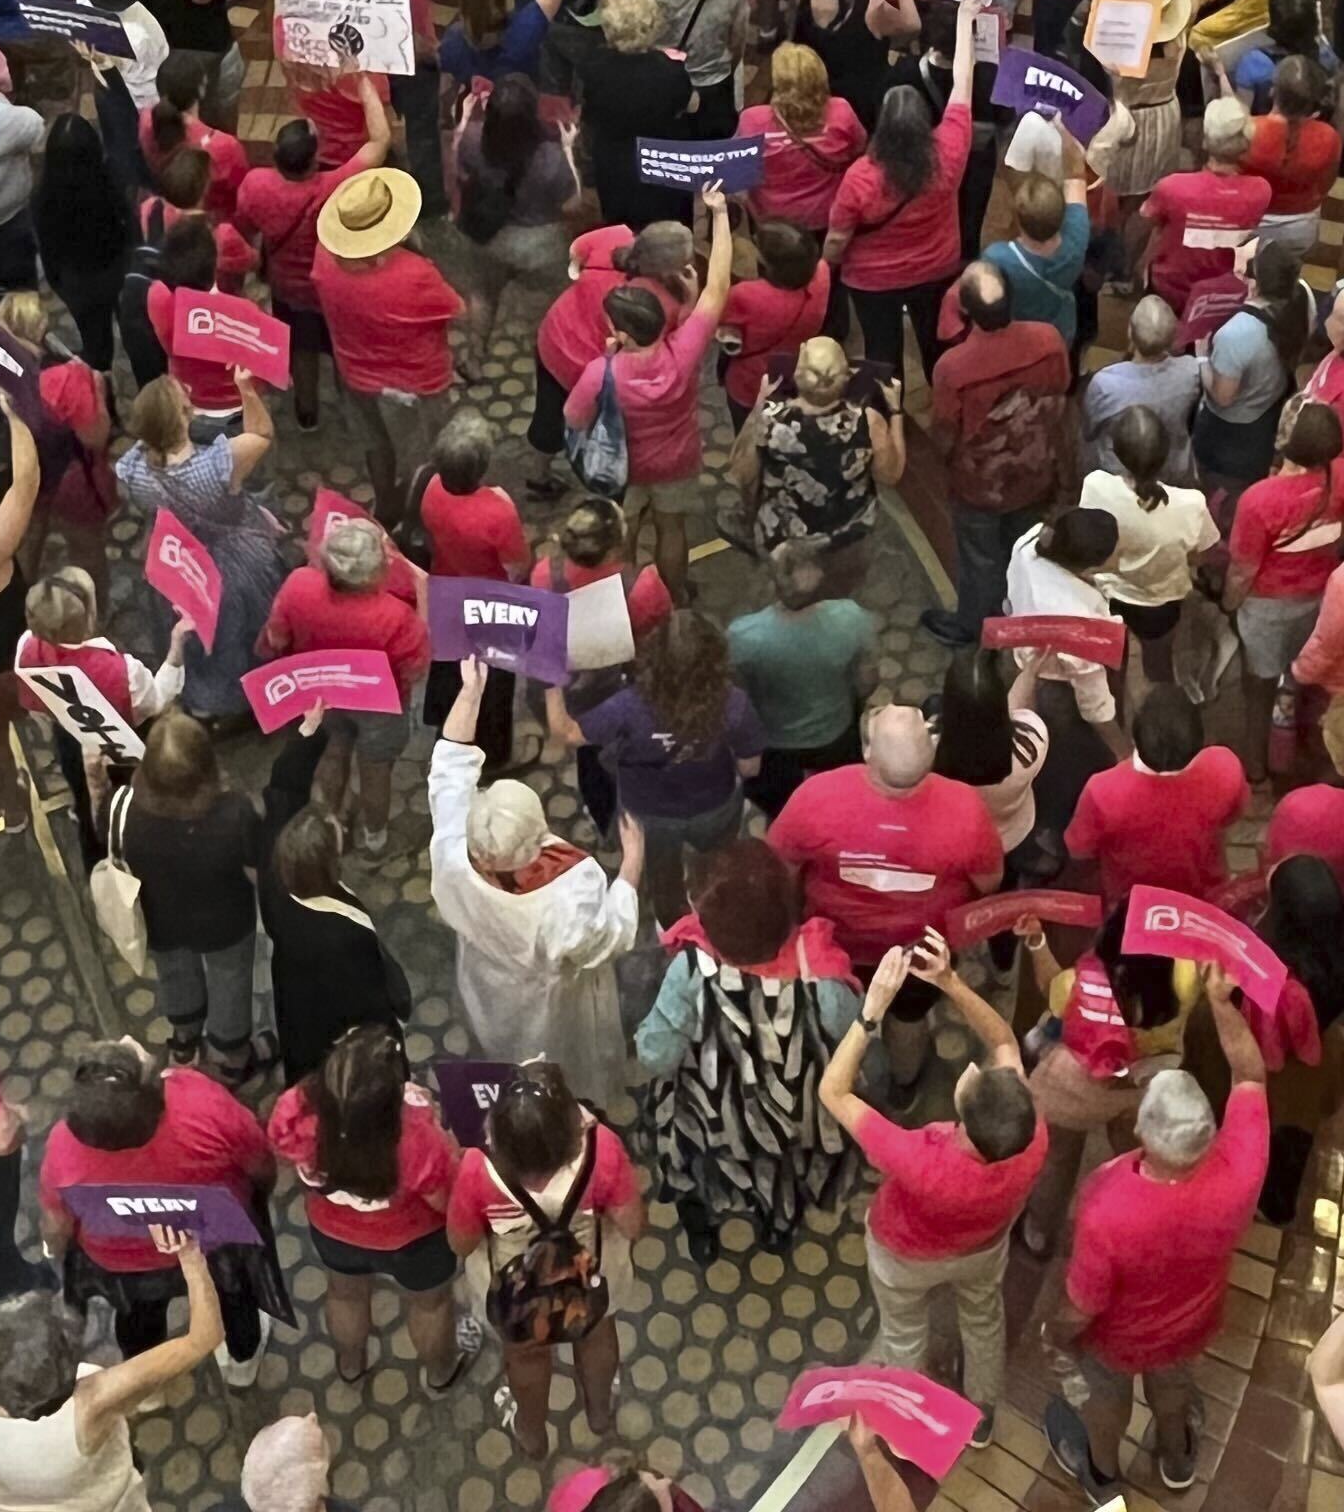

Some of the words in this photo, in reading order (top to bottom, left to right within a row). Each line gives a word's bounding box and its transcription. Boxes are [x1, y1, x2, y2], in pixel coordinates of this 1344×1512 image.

[1024, 66, 1084, 101] EVERY
[464, 599, 538, 627] EVERY
[106, 1197, 197, 1216] EVERY
